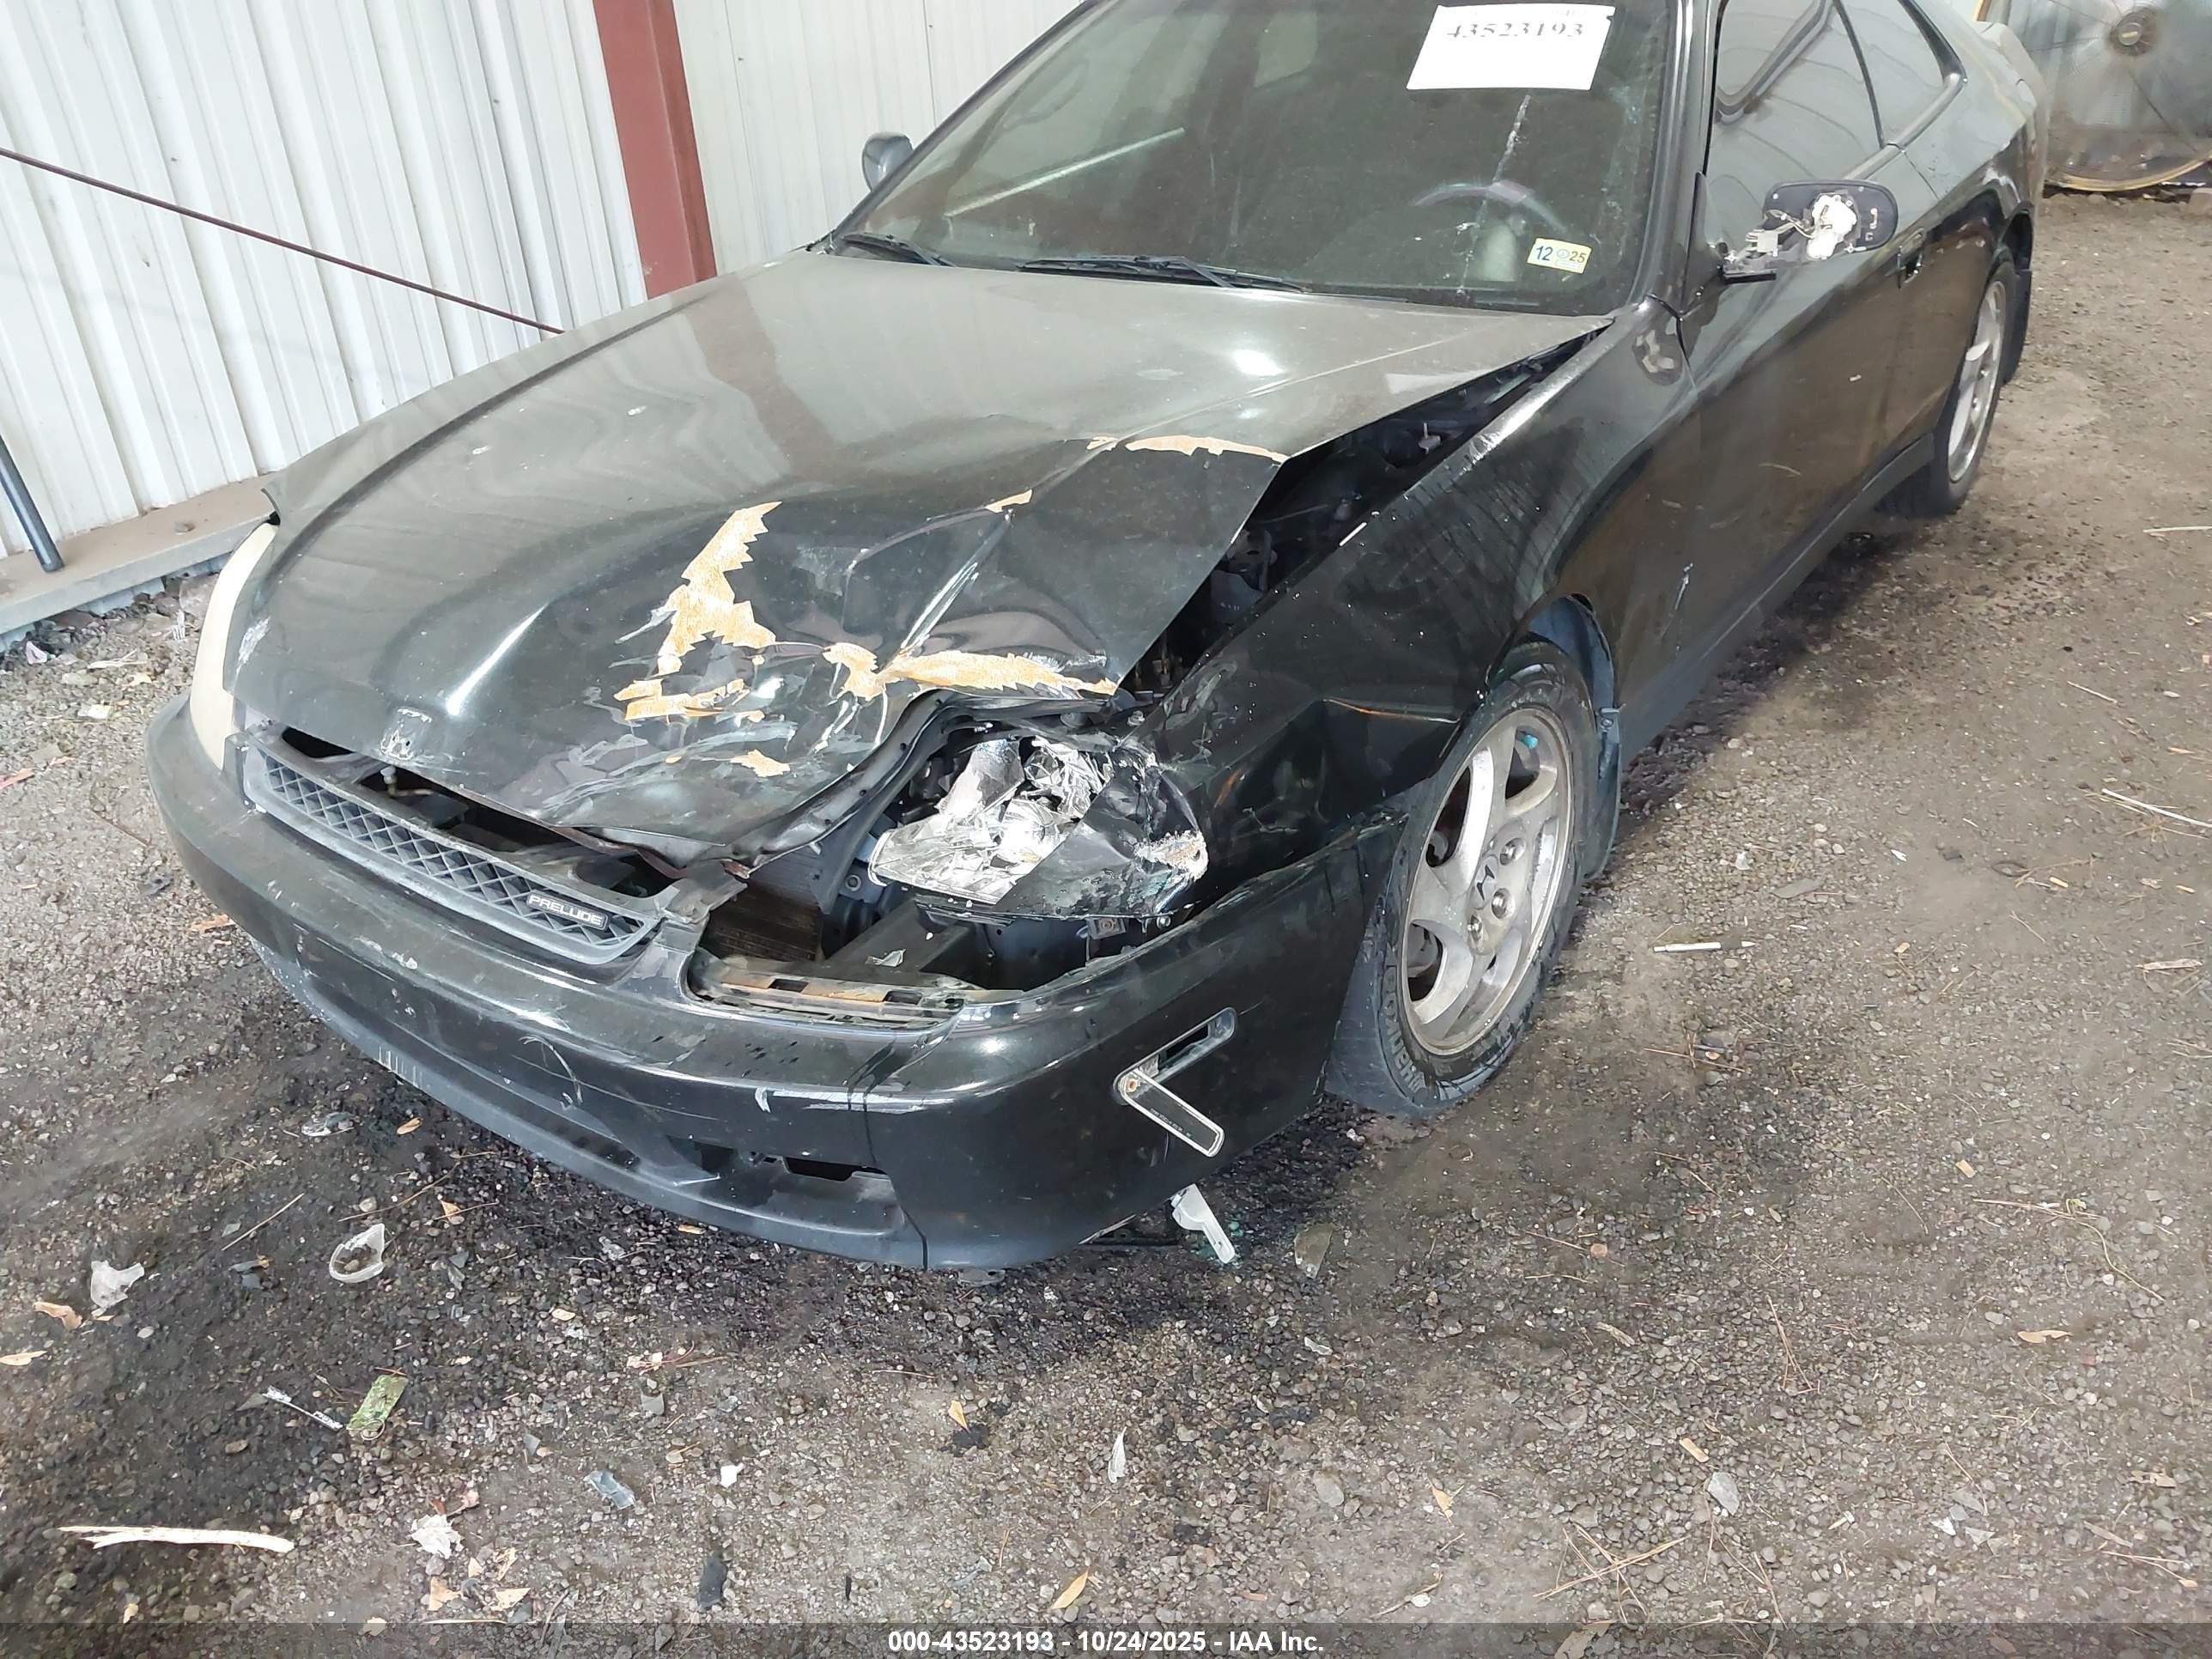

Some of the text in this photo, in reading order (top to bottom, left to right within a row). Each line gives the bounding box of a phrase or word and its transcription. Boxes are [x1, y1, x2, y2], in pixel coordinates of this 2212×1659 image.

[1445, 21, 1584, 39] 43523193
[1535, 245, 1587, 264] 12 25
[528, 894, 603, 926] PRELUDE
